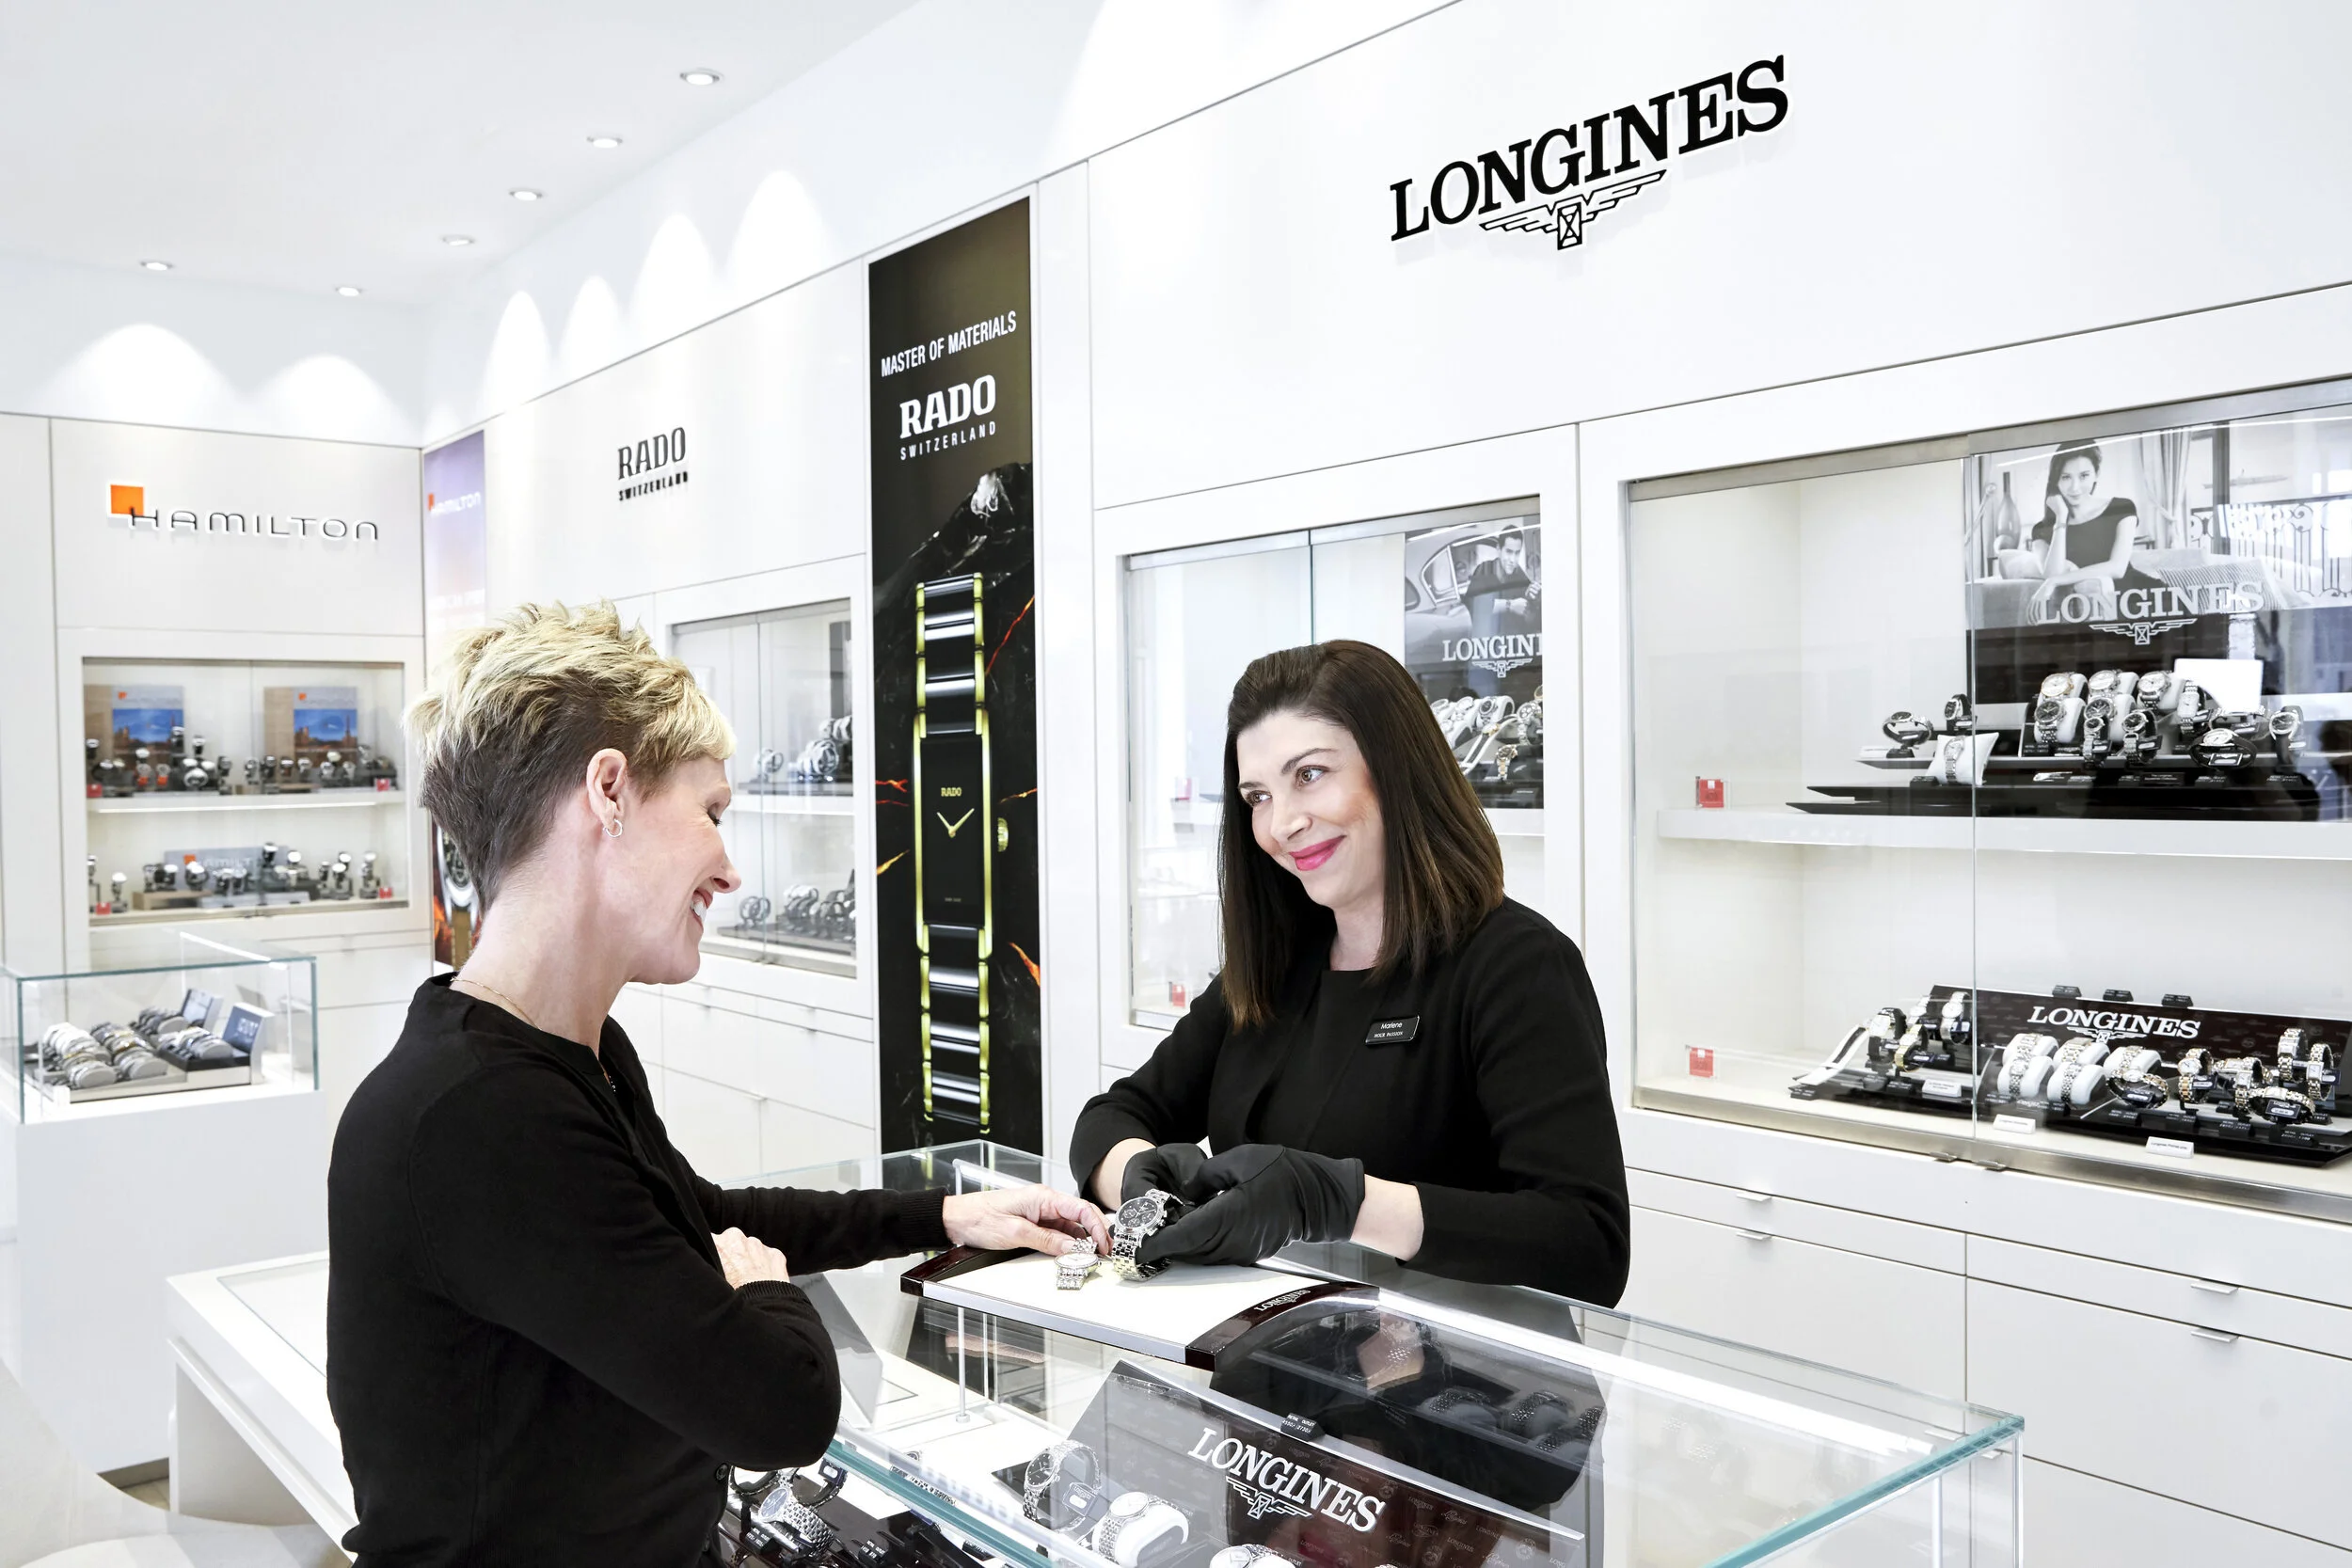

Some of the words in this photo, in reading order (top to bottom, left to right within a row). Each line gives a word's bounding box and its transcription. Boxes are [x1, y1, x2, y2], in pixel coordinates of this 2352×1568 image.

[1390, 54, 1788, 242] LONGINES
[881, 344, 926, 377] MASTER
[929, 337, 945, 361] OF
[948, 310, 1017, 355] MATERIALS
[899, 374, 996, 439] RADO
[617, 426, 686, 481] RADO
[899, 420, 996, 461] SWITZERLAND
[619, 470, 688, 501] SWITZERLAND
[130, 506, 378, 541] HAMILTON
[2036, 580, 2265, 626] LONGINES
[941, 787, 962, 797] RADO
[2026, 1006, 2201, 1039] LONGINES
[1253, 1289, 1311, 1312] LONGINES
[1187, 1427, 1386, 1533] LONGINES
